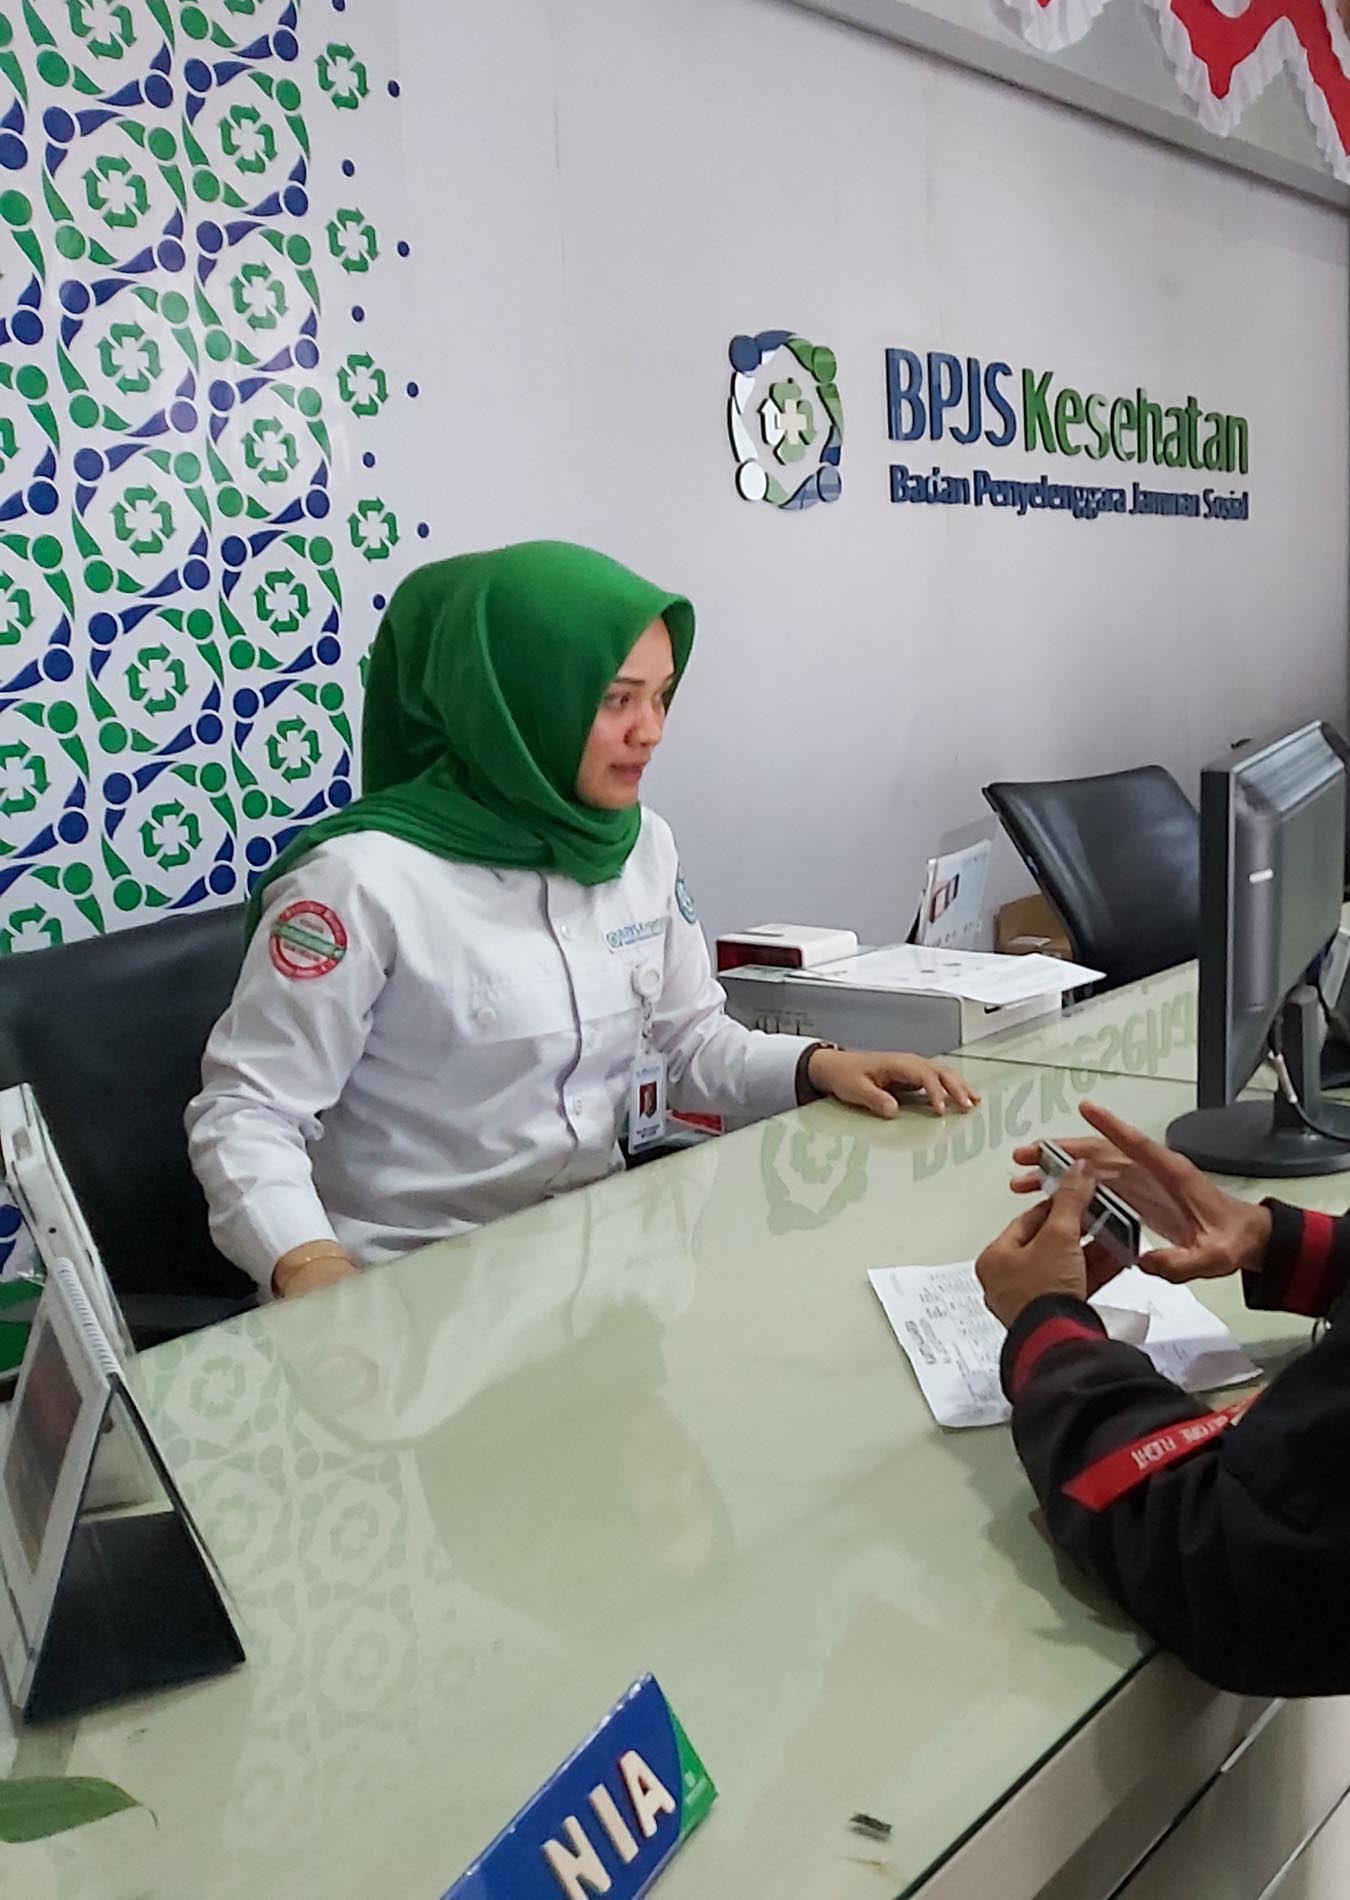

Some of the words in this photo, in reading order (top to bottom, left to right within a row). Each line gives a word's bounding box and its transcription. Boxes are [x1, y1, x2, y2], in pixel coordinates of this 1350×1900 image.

[885, 347, 1018, 448] BPJS
[1021, 367, 1249, 475] Kesehatan
[889, 463, 970, 505] Badan
[973, 469, 1127, 520] Penyelenggara
[1203, 488, 1249, 520] Sosial
[541, 1750, 677, 1900] NIA
